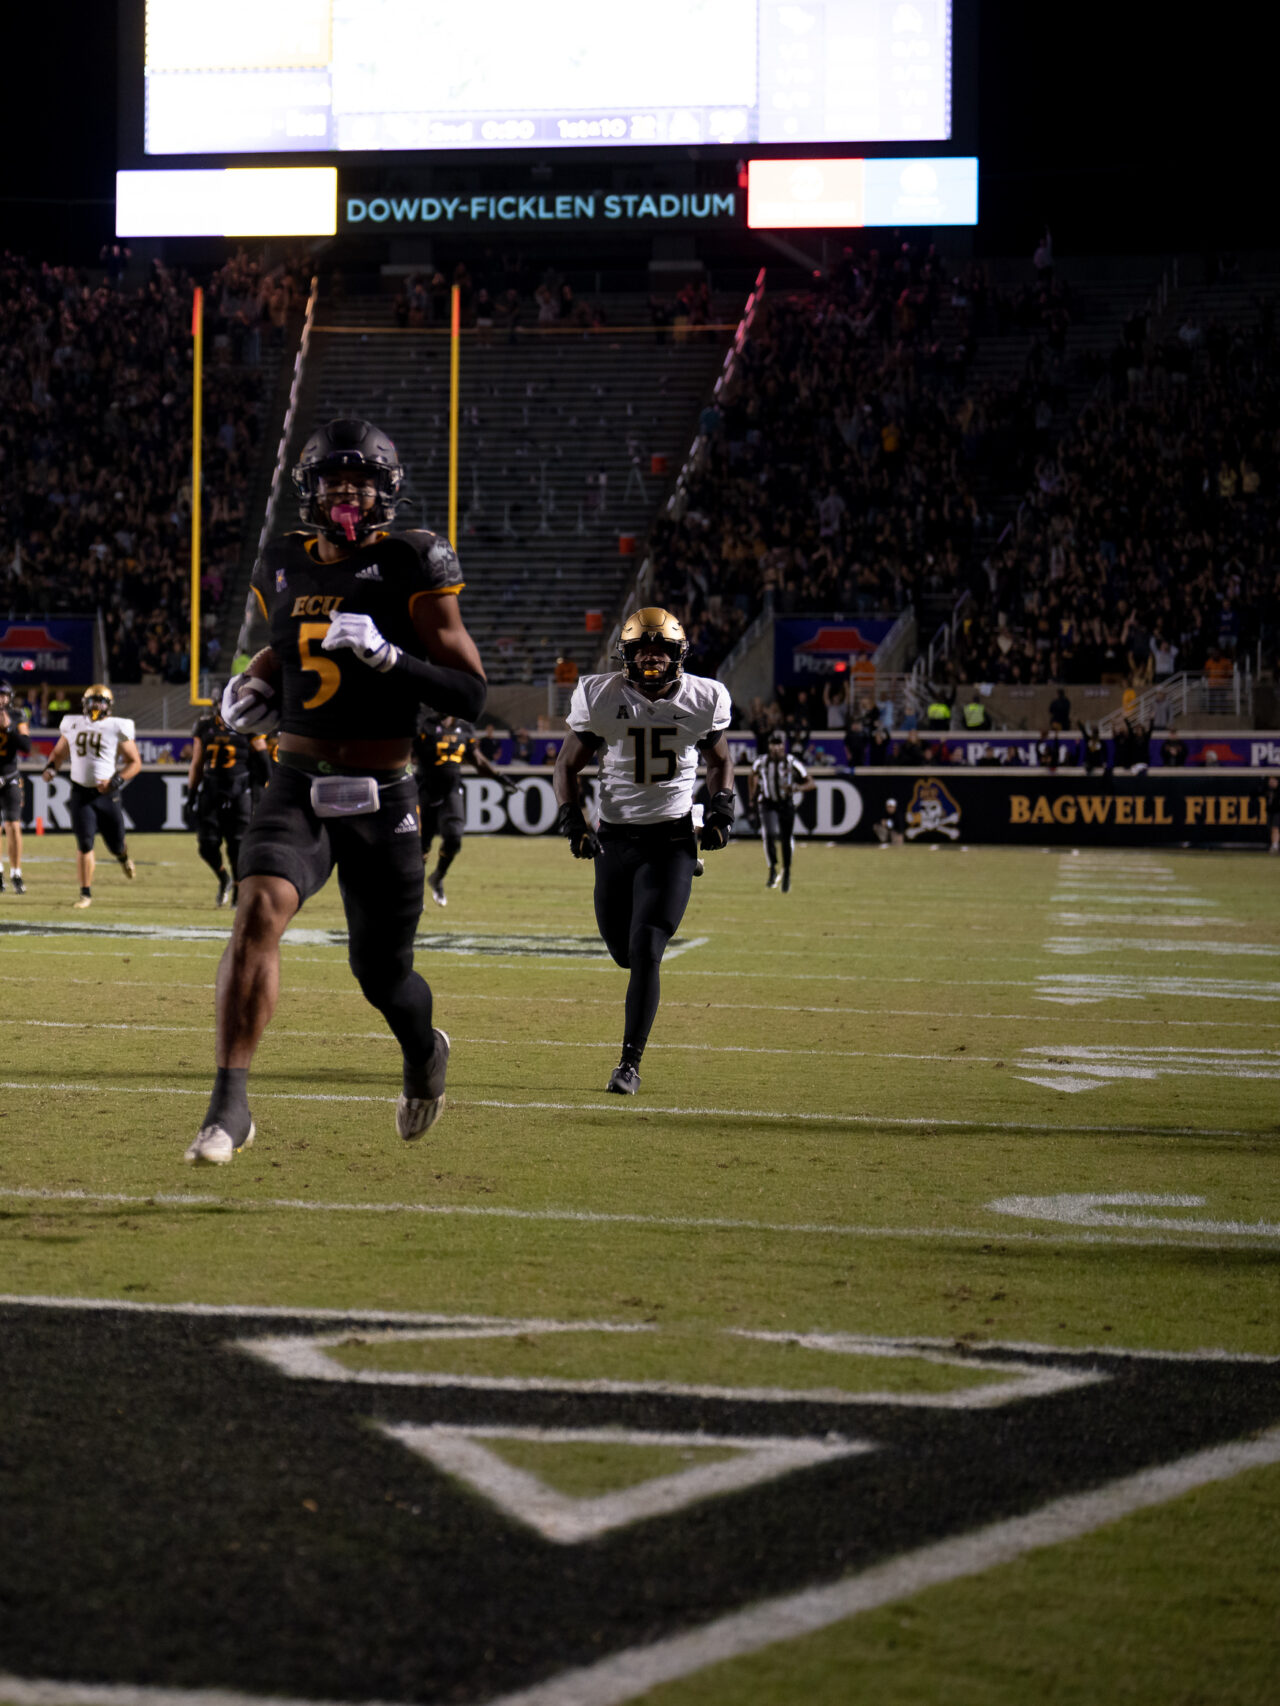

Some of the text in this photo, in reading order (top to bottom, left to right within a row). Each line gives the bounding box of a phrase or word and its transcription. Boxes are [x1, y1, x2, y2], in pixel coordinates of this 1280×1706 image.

[346, 197, 595, 222] DOWDY-FICKLEN
[604, 193, 735, 219] STADIUM
[290, 594, 345, 619] ECU
[297, 621, 342, 711] 5
[76, 732, 107, 757] 94
[206, 743, 237, 769] 73
[627, 727, 677, 784] 15
[1009, 794, 1174, 825] BAGWELL
